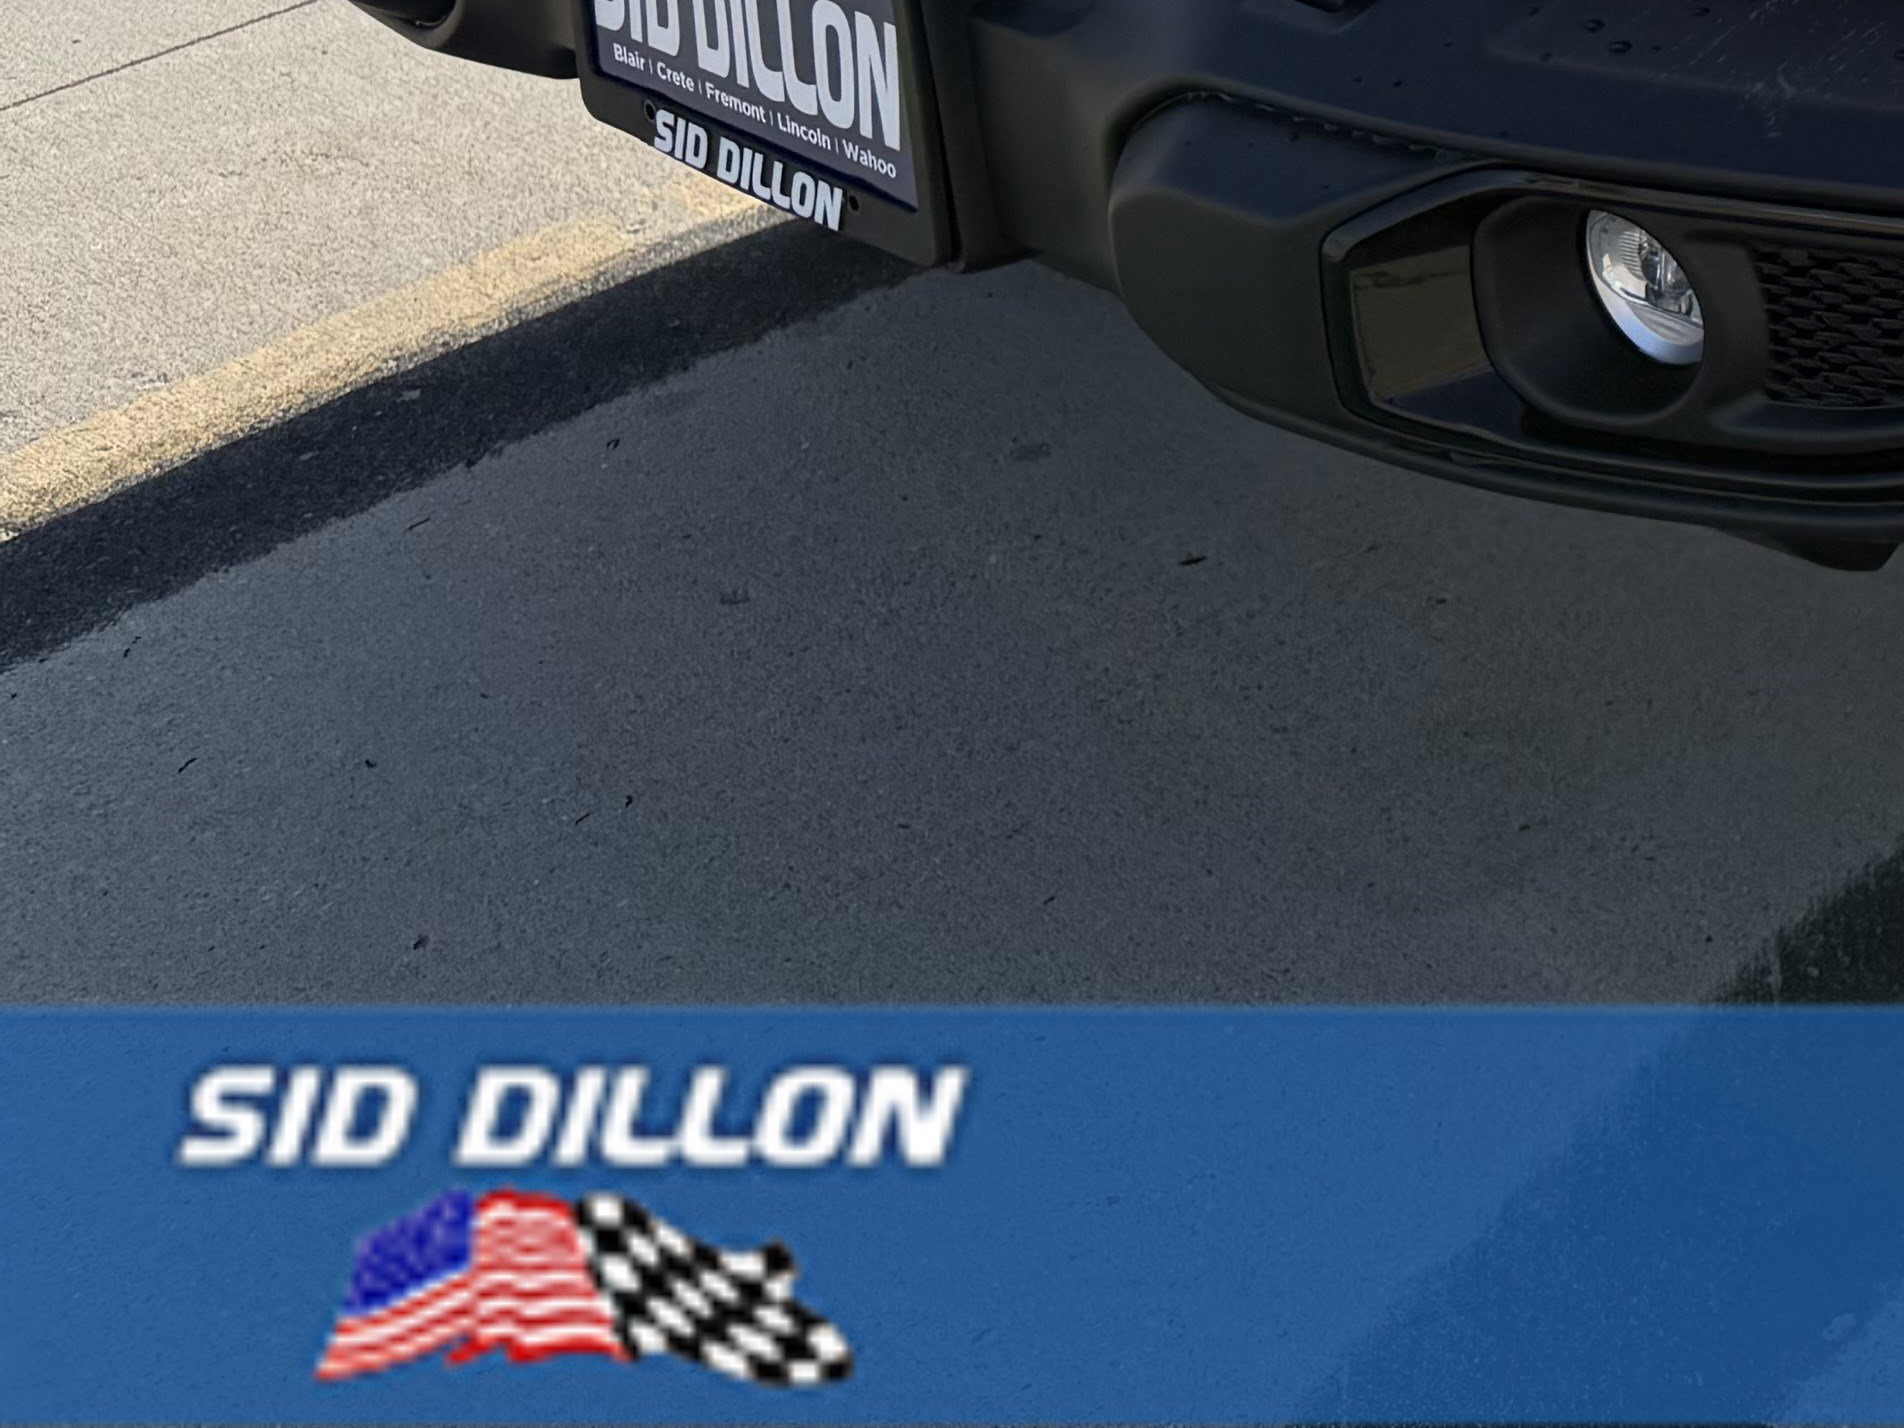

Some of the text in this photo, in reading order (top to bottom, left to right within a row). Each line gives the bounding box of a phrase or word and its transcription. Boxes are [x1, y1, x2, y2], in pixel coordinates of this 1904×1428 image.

[613, 43, 898, 180] Blair Crete Fremont Lincoln Wahoo
[653, 108, 844, 232] SID DILLON
